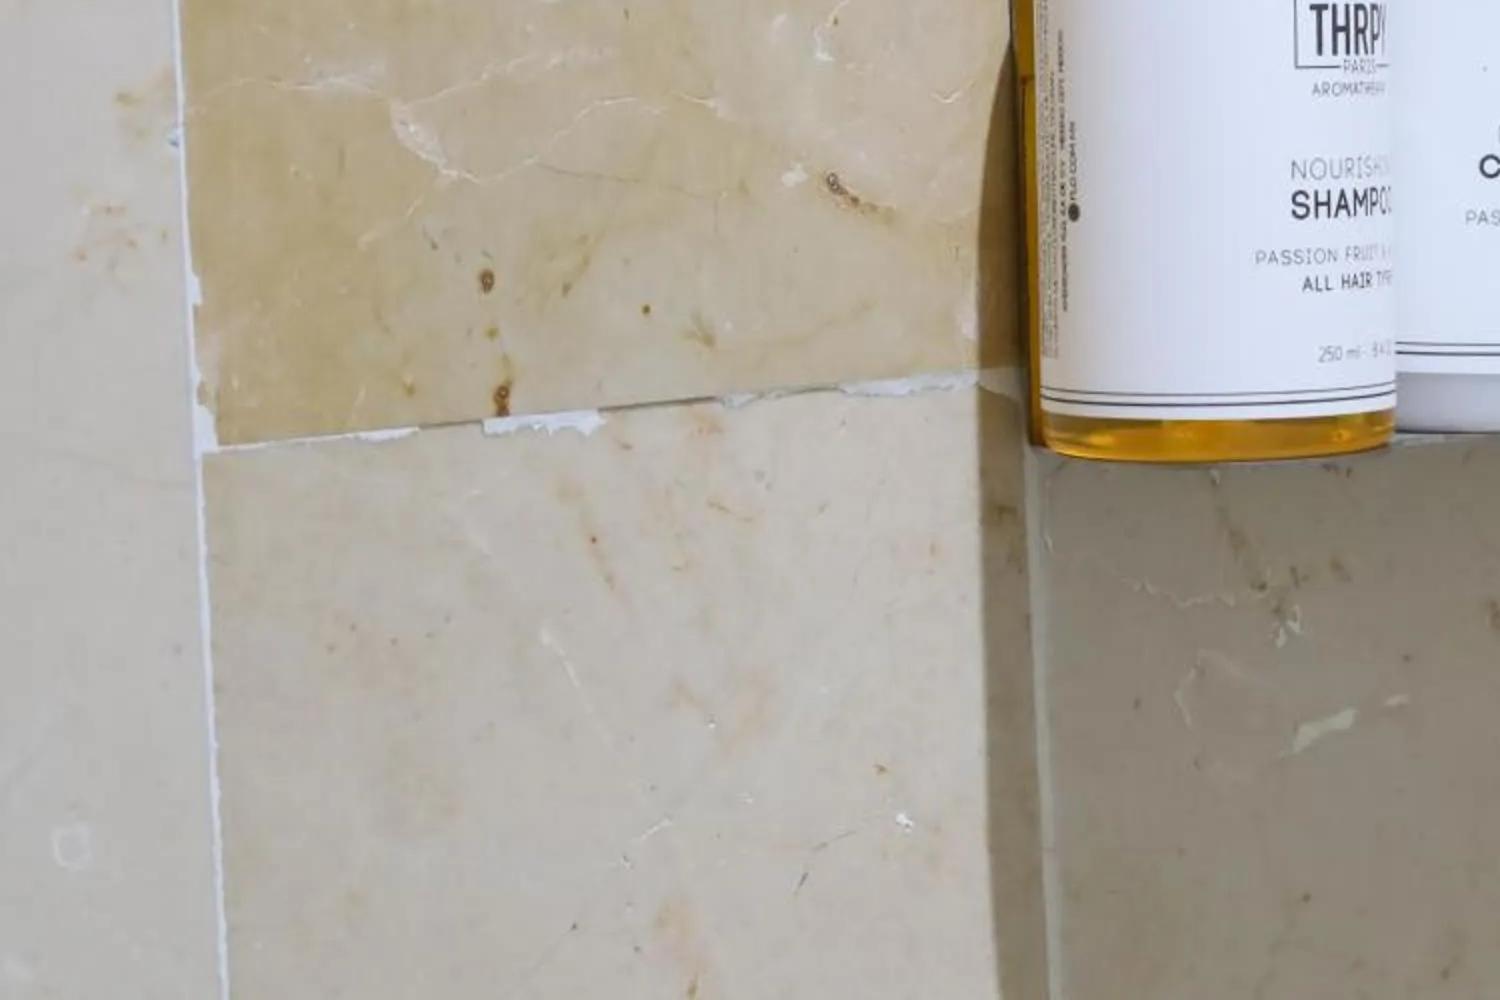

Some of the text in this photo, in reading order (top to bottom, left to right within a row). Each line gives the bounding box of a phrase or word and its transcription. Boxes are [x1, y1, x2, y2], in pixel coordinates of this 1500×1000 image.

[1255, 248, 1337, 265] PASSION
[1302, 275, 1333, 293] ALL
[1341, 272, 1373, 289] HAIR
[1318, 345, 1343, 363] 250
